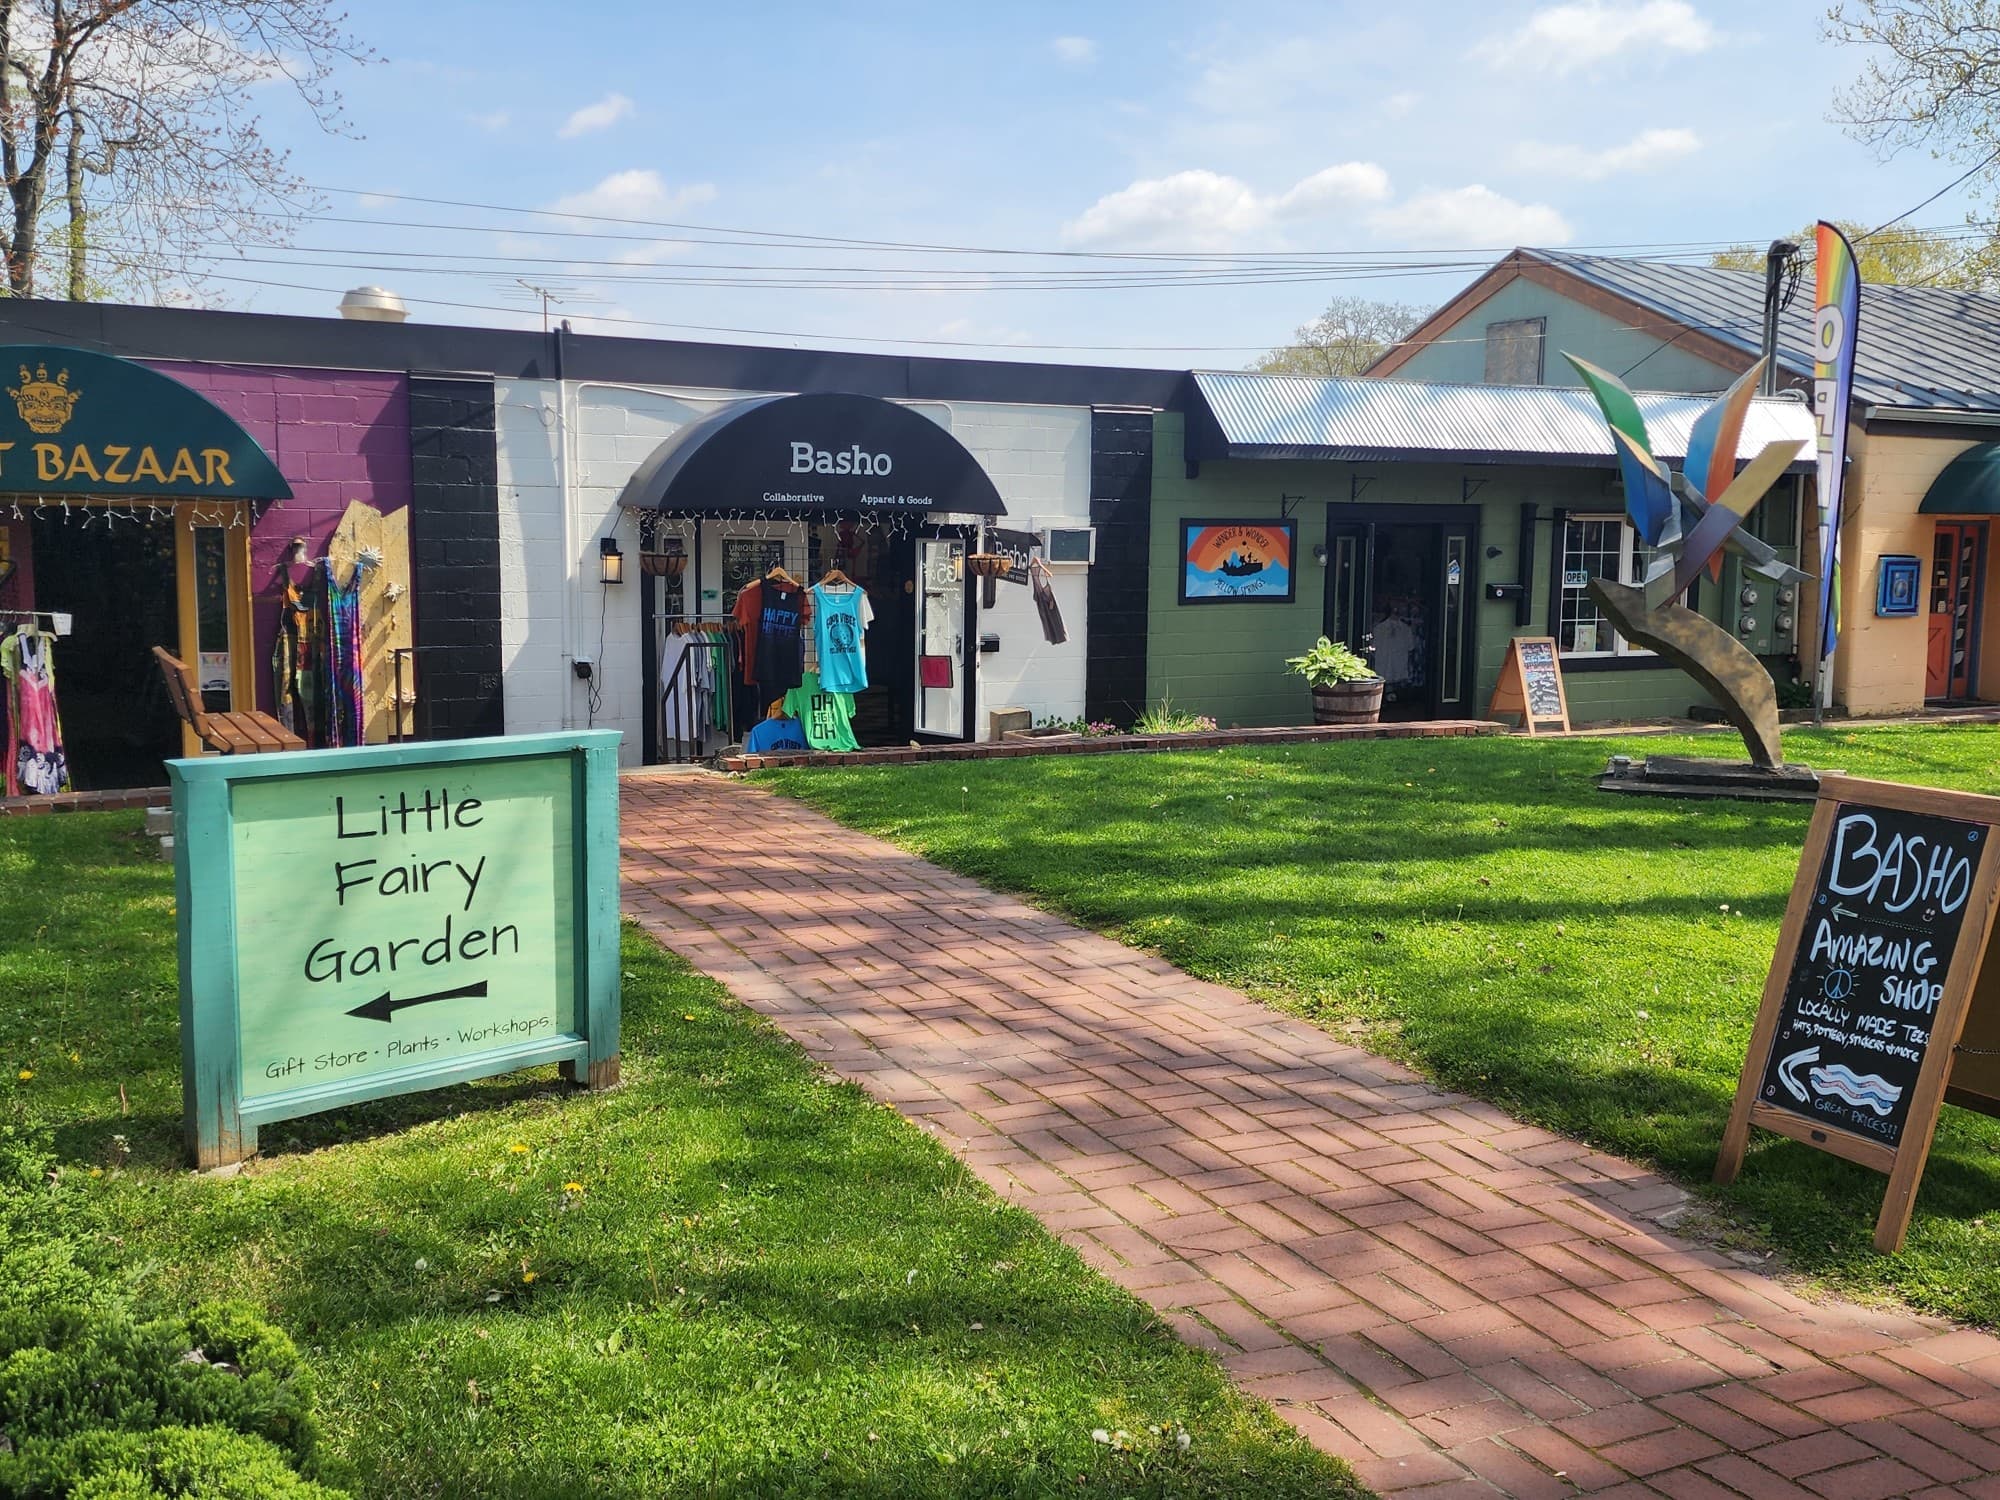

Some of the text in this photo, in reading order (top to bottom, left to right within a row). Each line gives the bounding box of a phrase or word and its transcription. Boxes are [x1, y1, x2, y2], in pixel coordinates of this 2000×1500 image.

[32, 443, 235, 486] BAZAAR
[790, 441, 893, 476] Basho
[763, 492, 933, 506] Collaborative Apparel & Goods
[728, 544, 760, 552] UNIQUE
[1212, 528, 1237, 549] WANDER
[1245, 527, 1270, 548] WONDER
[995, 541, 1028, 570] Basho
[1566, 573, 1587, 583] OPEN
[764, 607, 799, 626] HAPPY
[811, 693, 834, 711] OH
[813, 724, 837, 740] OH
[336, 788, 484, 839] Little
[1828, 813, 1970, 914] BASHO
[335, 854, 486, 911] Fairy
[304, 914, 519, 983] Garden
[1879, 975, 1944, 1014] SHOP
[1797, 998, 1850, 1027] LOCALLY
[1856, 1015, 1897, 1037] MADE
[265, 1055, 306, 1080] Gift
[314, 1050, 368, 1071] Store
[387, 1035, 440, 1058] Plants
[1814, 1098, 1849, 1117] GREAT
